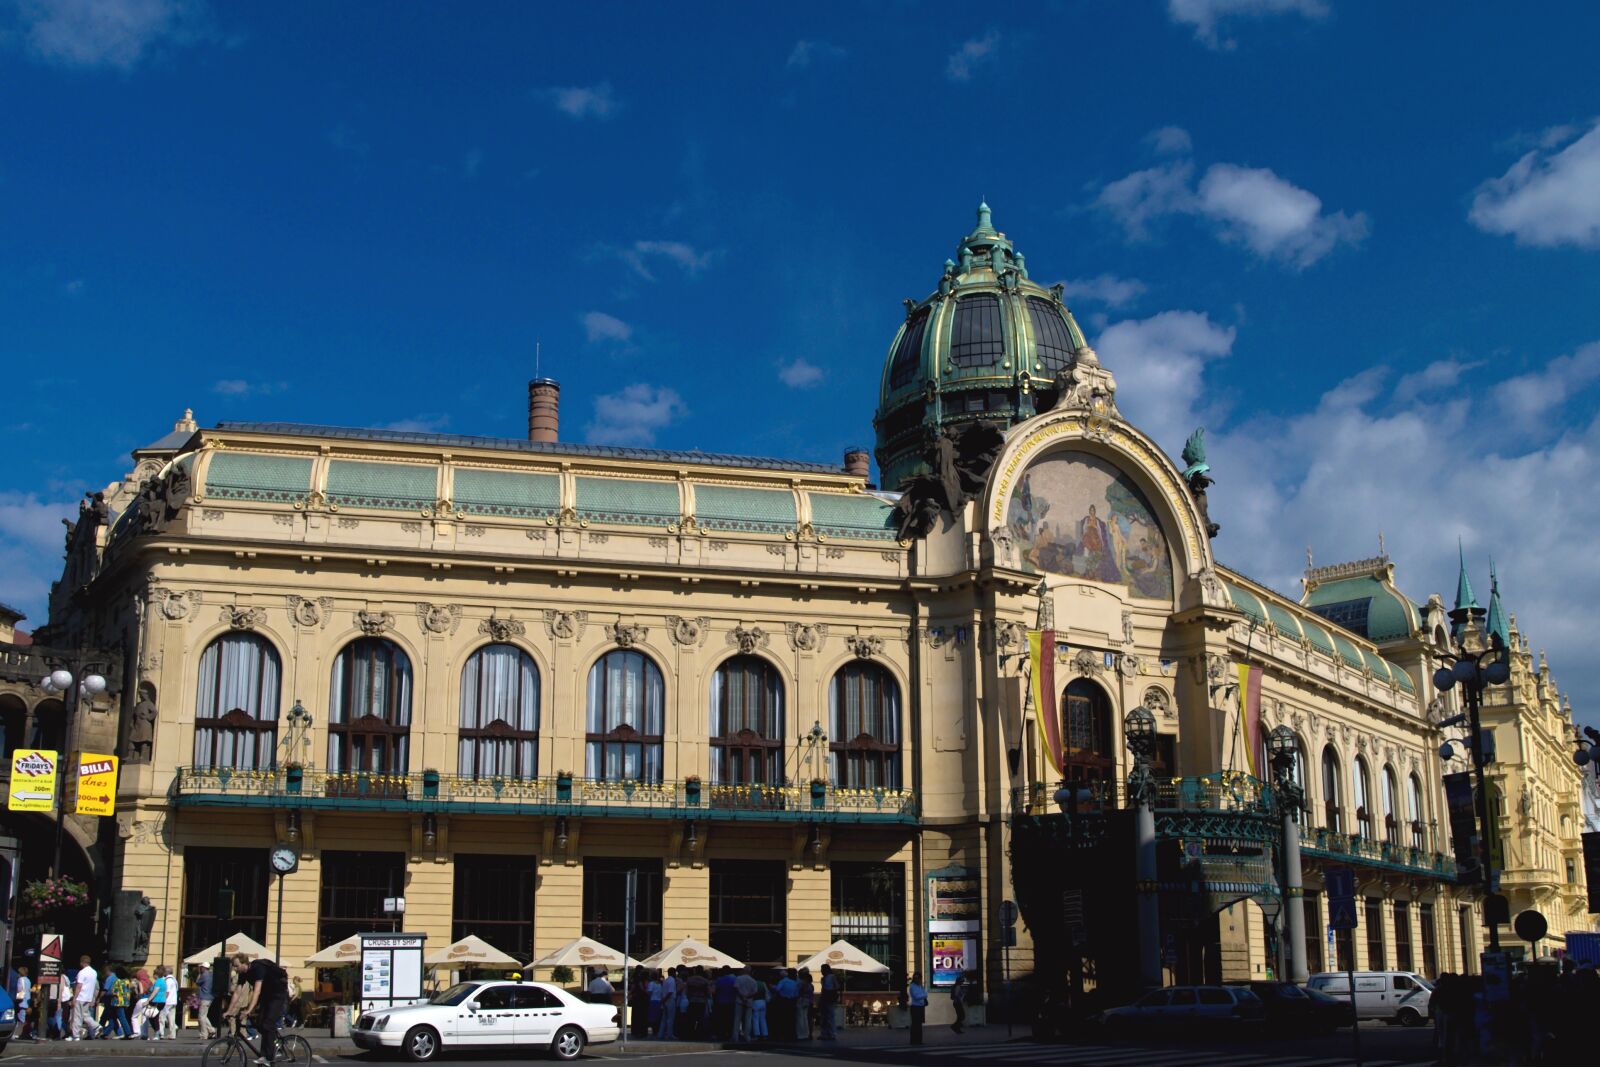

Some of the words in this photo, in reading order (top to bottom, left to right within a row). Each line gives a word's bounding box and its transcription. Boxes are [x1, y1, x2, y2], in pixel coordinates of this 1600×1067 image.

[80, 762, 112, 775] BILLA
[82, 776, 108, 787] dnes
[933, 956, 966, 969] FOK
